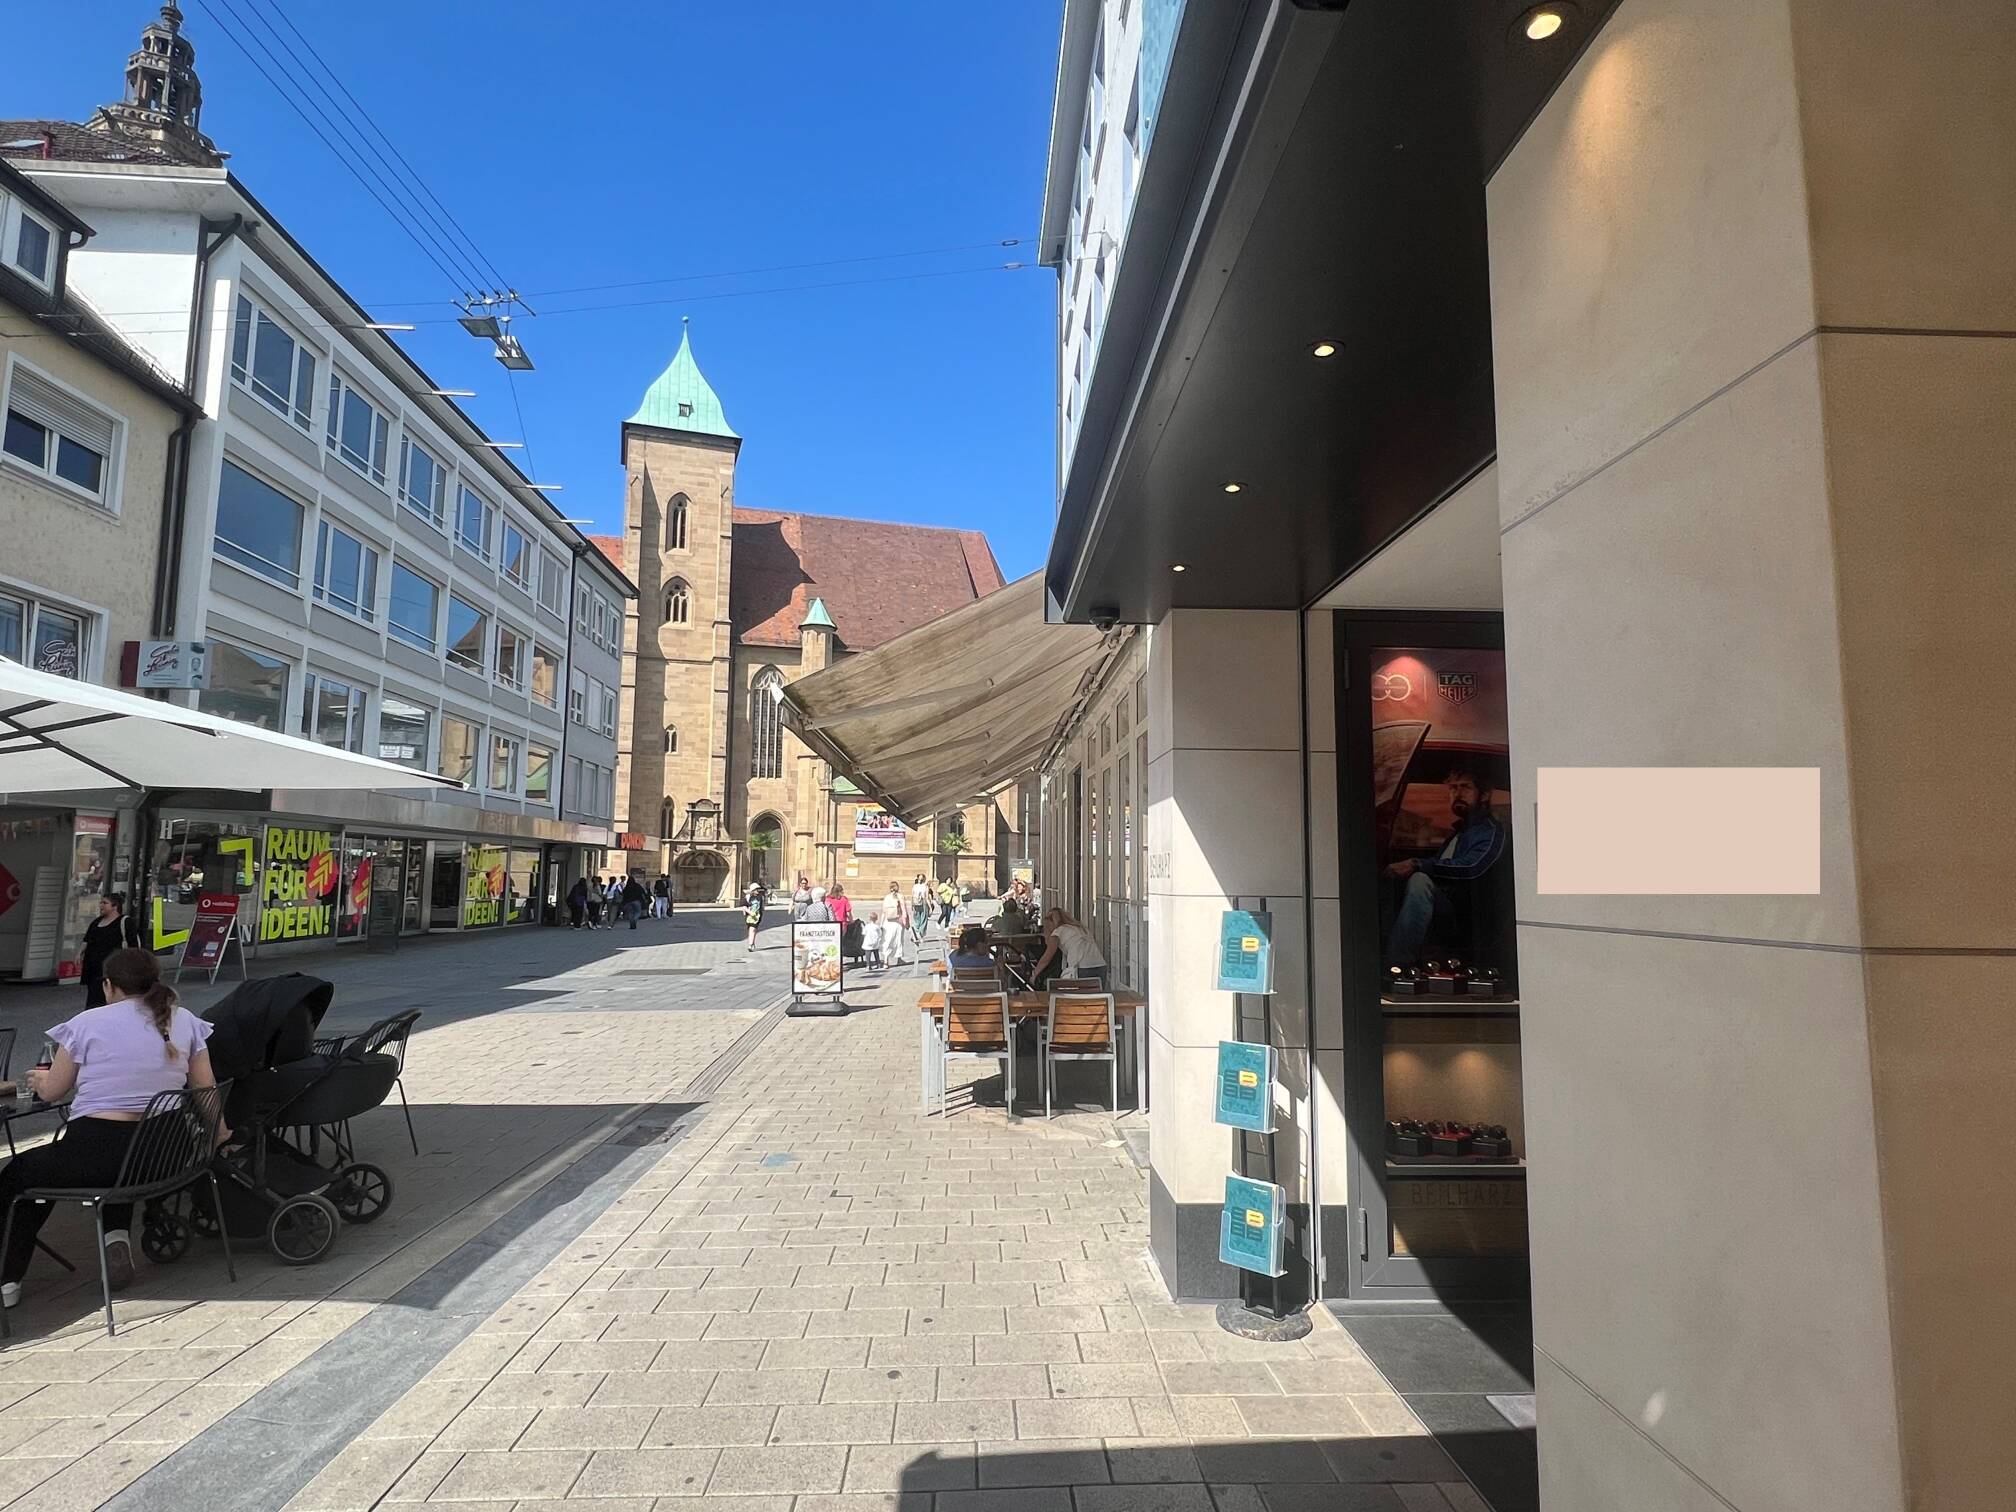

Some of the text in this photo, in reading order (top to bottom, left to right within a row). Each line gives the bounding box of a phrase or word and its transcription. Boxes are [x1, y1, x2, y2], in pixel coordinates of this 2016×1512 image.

[1440, 687, 1474, 701] HEUER
[1442, 674, 1473, 685] TAG
[267, 827, 331, 861] RAUM
[263, 863, 308, 902] FÜR
[260, 904, 332, 941] IDEEN!
[464, 901, 499, 925] IDEEN!
